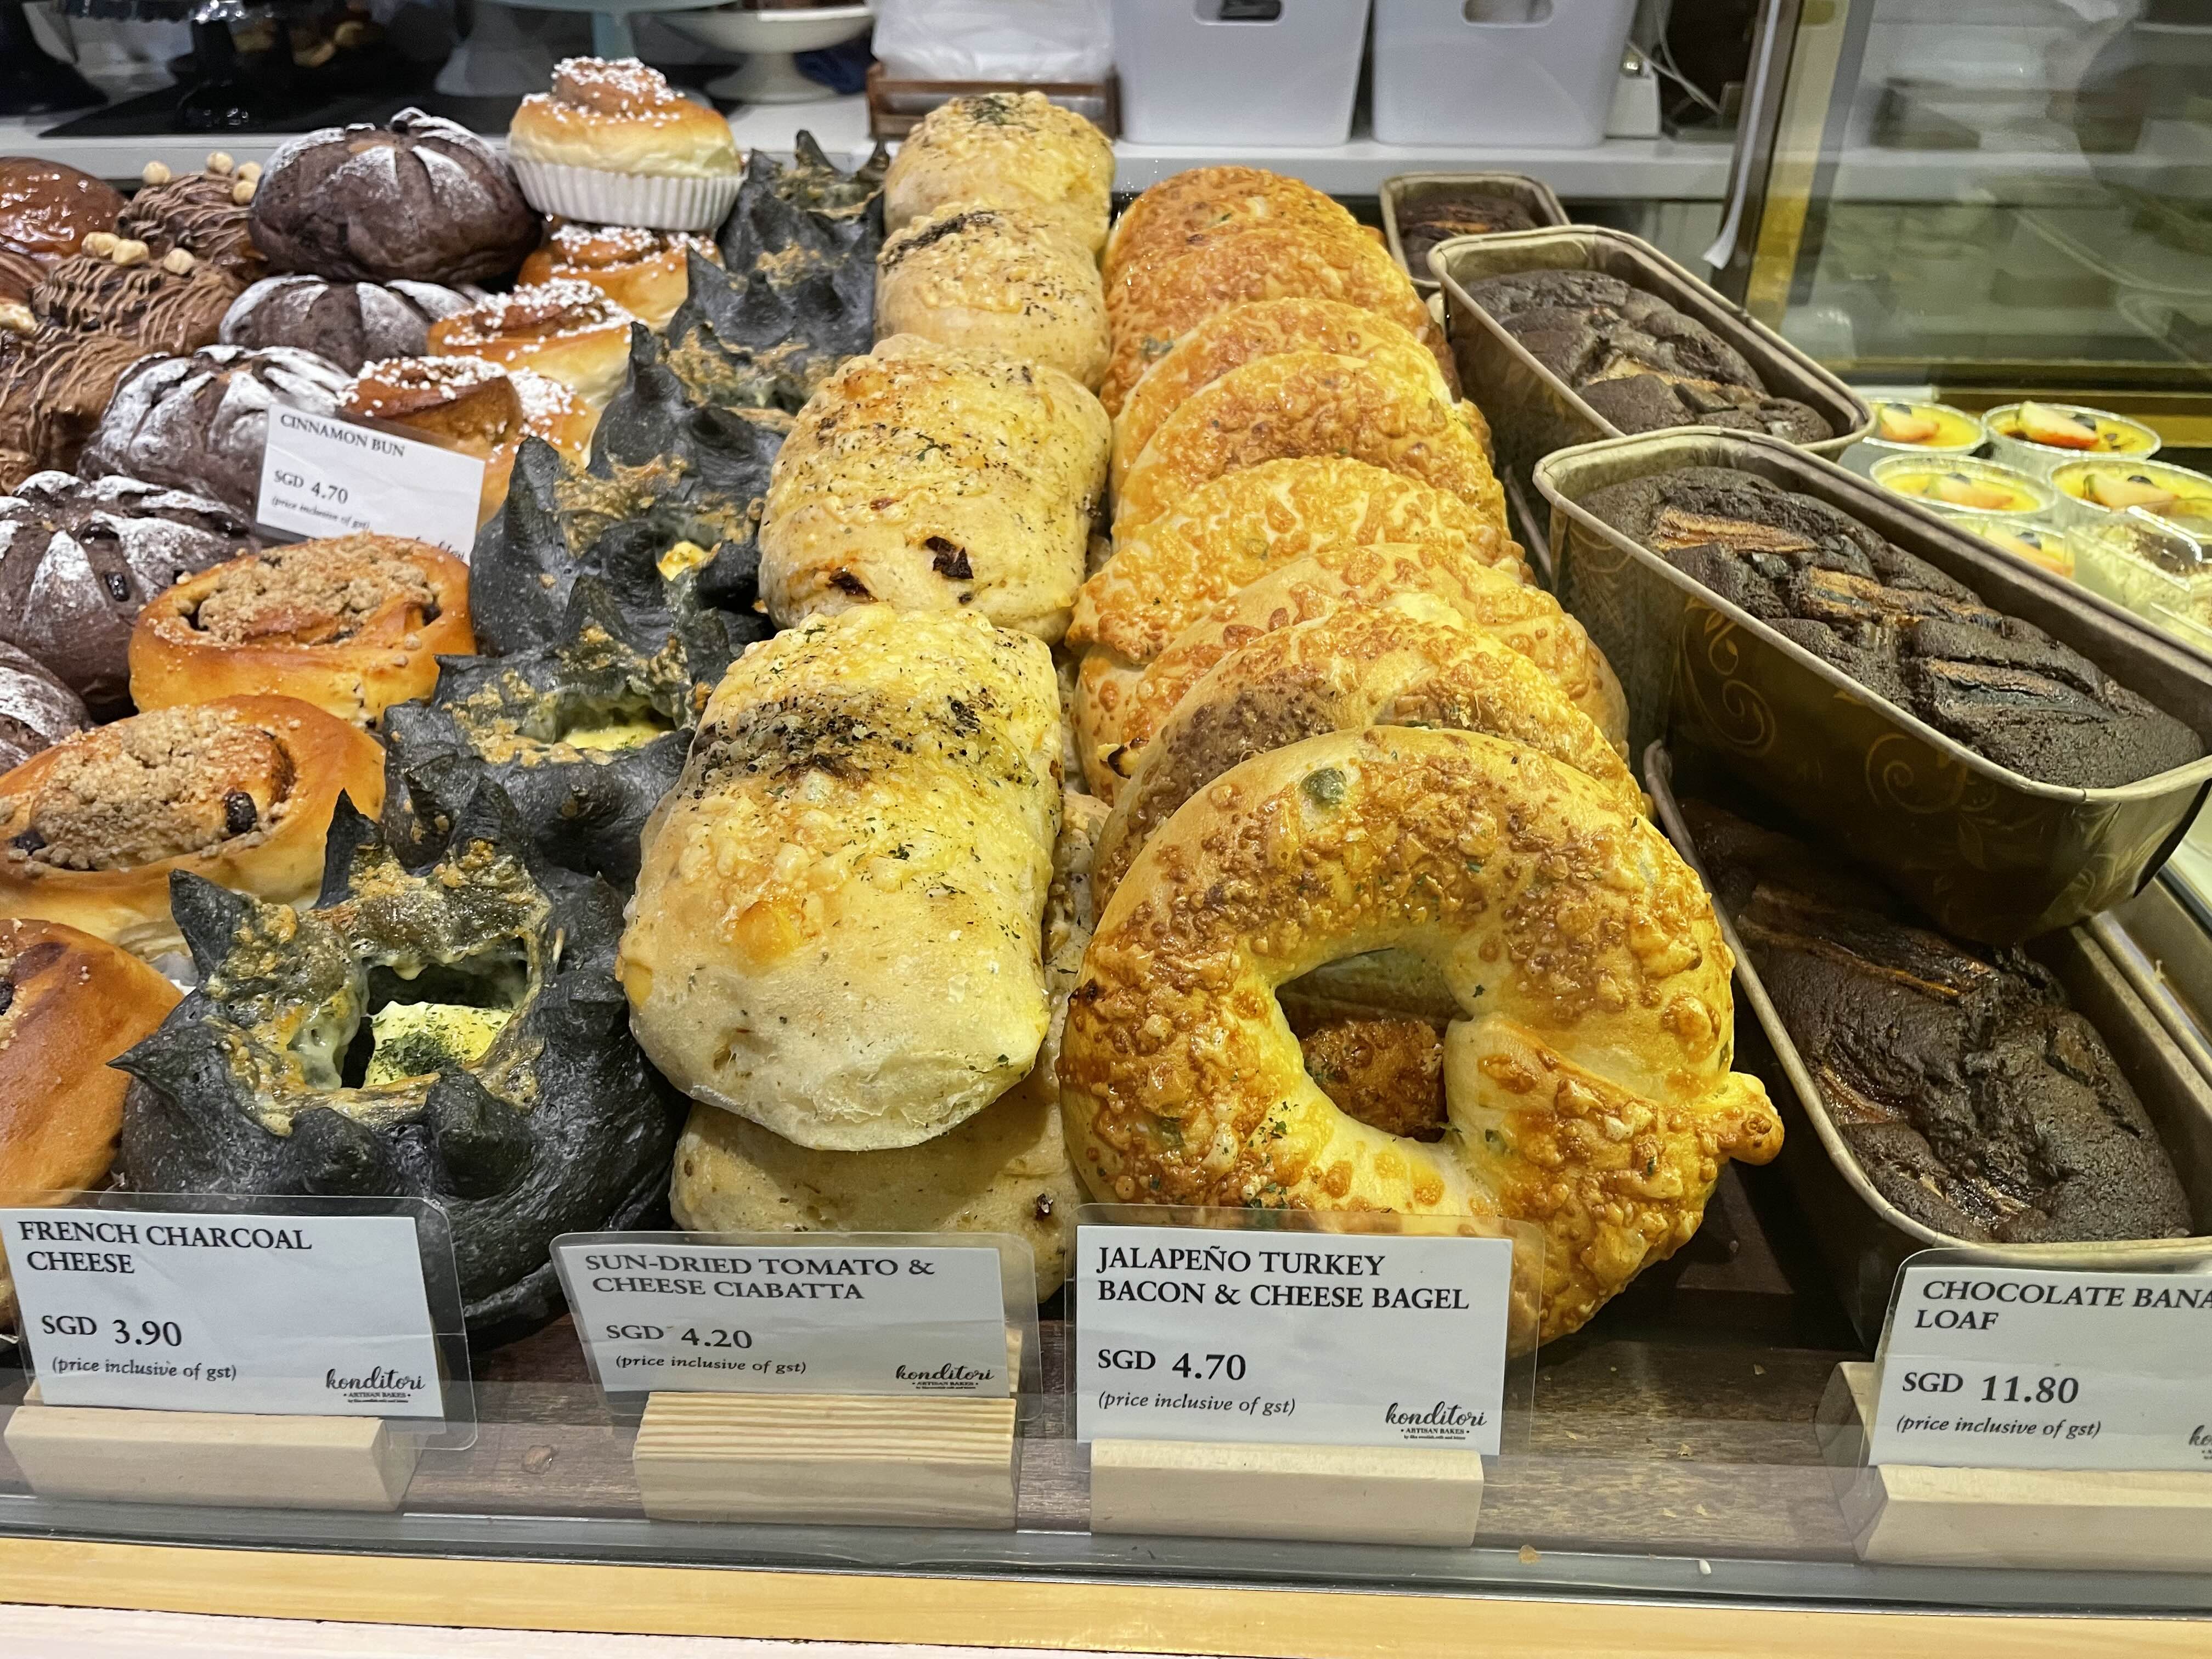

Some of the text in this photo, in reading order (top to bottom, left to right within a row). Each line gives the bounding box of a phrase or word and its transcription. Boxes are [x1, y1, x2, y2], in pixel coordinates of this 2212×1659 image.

[281, 414, 405, 457] CINNAMON BUN
[274, 470, 348, 504] SGD 4.70
[17, 1221, 312, 1250] FRENCH CHARCOAL
[27, 1251, 135, 1274] CHEESE
[585, 1255, 935, 1276] SUN-DRIED TOMATO &
[1096, 1245, 1386, 1276] JALAPEÑO TURKEY
[592, 1277, 865, 1299] CHEESE CIABATTA
[1098, 1280, 1469, 1310] BACON & CHEESE BAGEL
[1923, 1280, 2125, 1307] CHOCOLATE
[41, 1315, 182, 1347] SGD 3.90
[1915, 1310, 1999, 1330] LOAF
[606, 1325, 752, 1349] SGD 4.20
[52, 1357, 236, 1381] (price inclusive of gst)
[616, 1355, 806, 1374] (price inclusive of gst)
[895, 1363, 995, 1380] konditori
[1098, 1349, 1246, 1381] SGD 4.70
[326, 1365, 425, 1390] konditori
[1902, 1372, 2079, 1404] SGD 11.80
[1098, 1391, 1295, 1417] (price inclusive of gst)
[1385, 1401, 1487, 1426] konditori
[1897, 1415, 2101, 1440] (price inclusive of gst)
